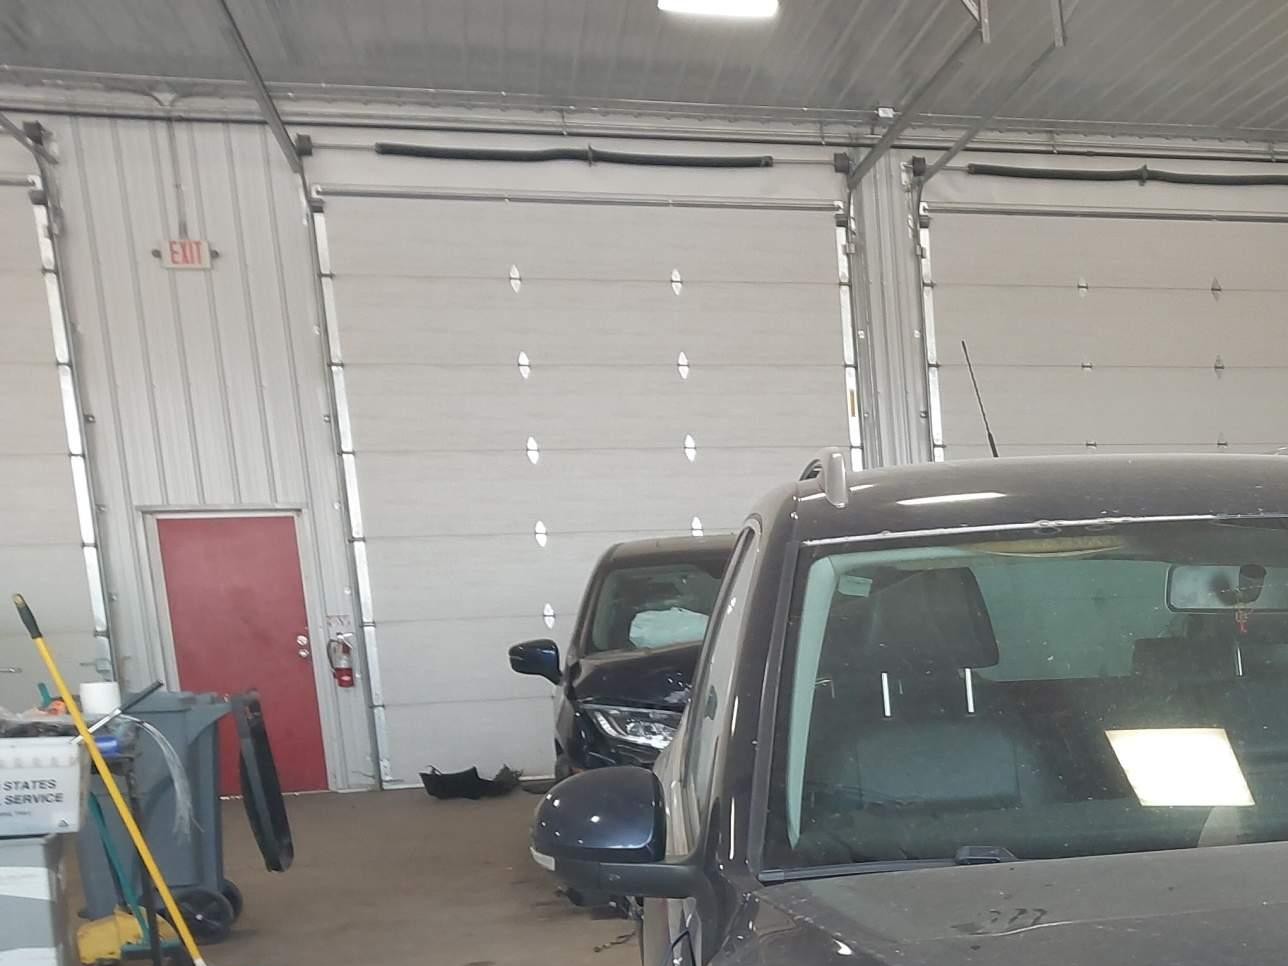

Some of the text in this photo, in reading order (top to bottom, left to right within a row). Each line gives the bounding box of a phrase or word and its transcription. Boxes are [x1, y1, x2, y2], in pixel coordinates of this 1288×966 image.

[169, 240, 202, 265] EXIT
[3, 779, 57, 791] STATES
[4, 792, 64, 804] SERVICE
